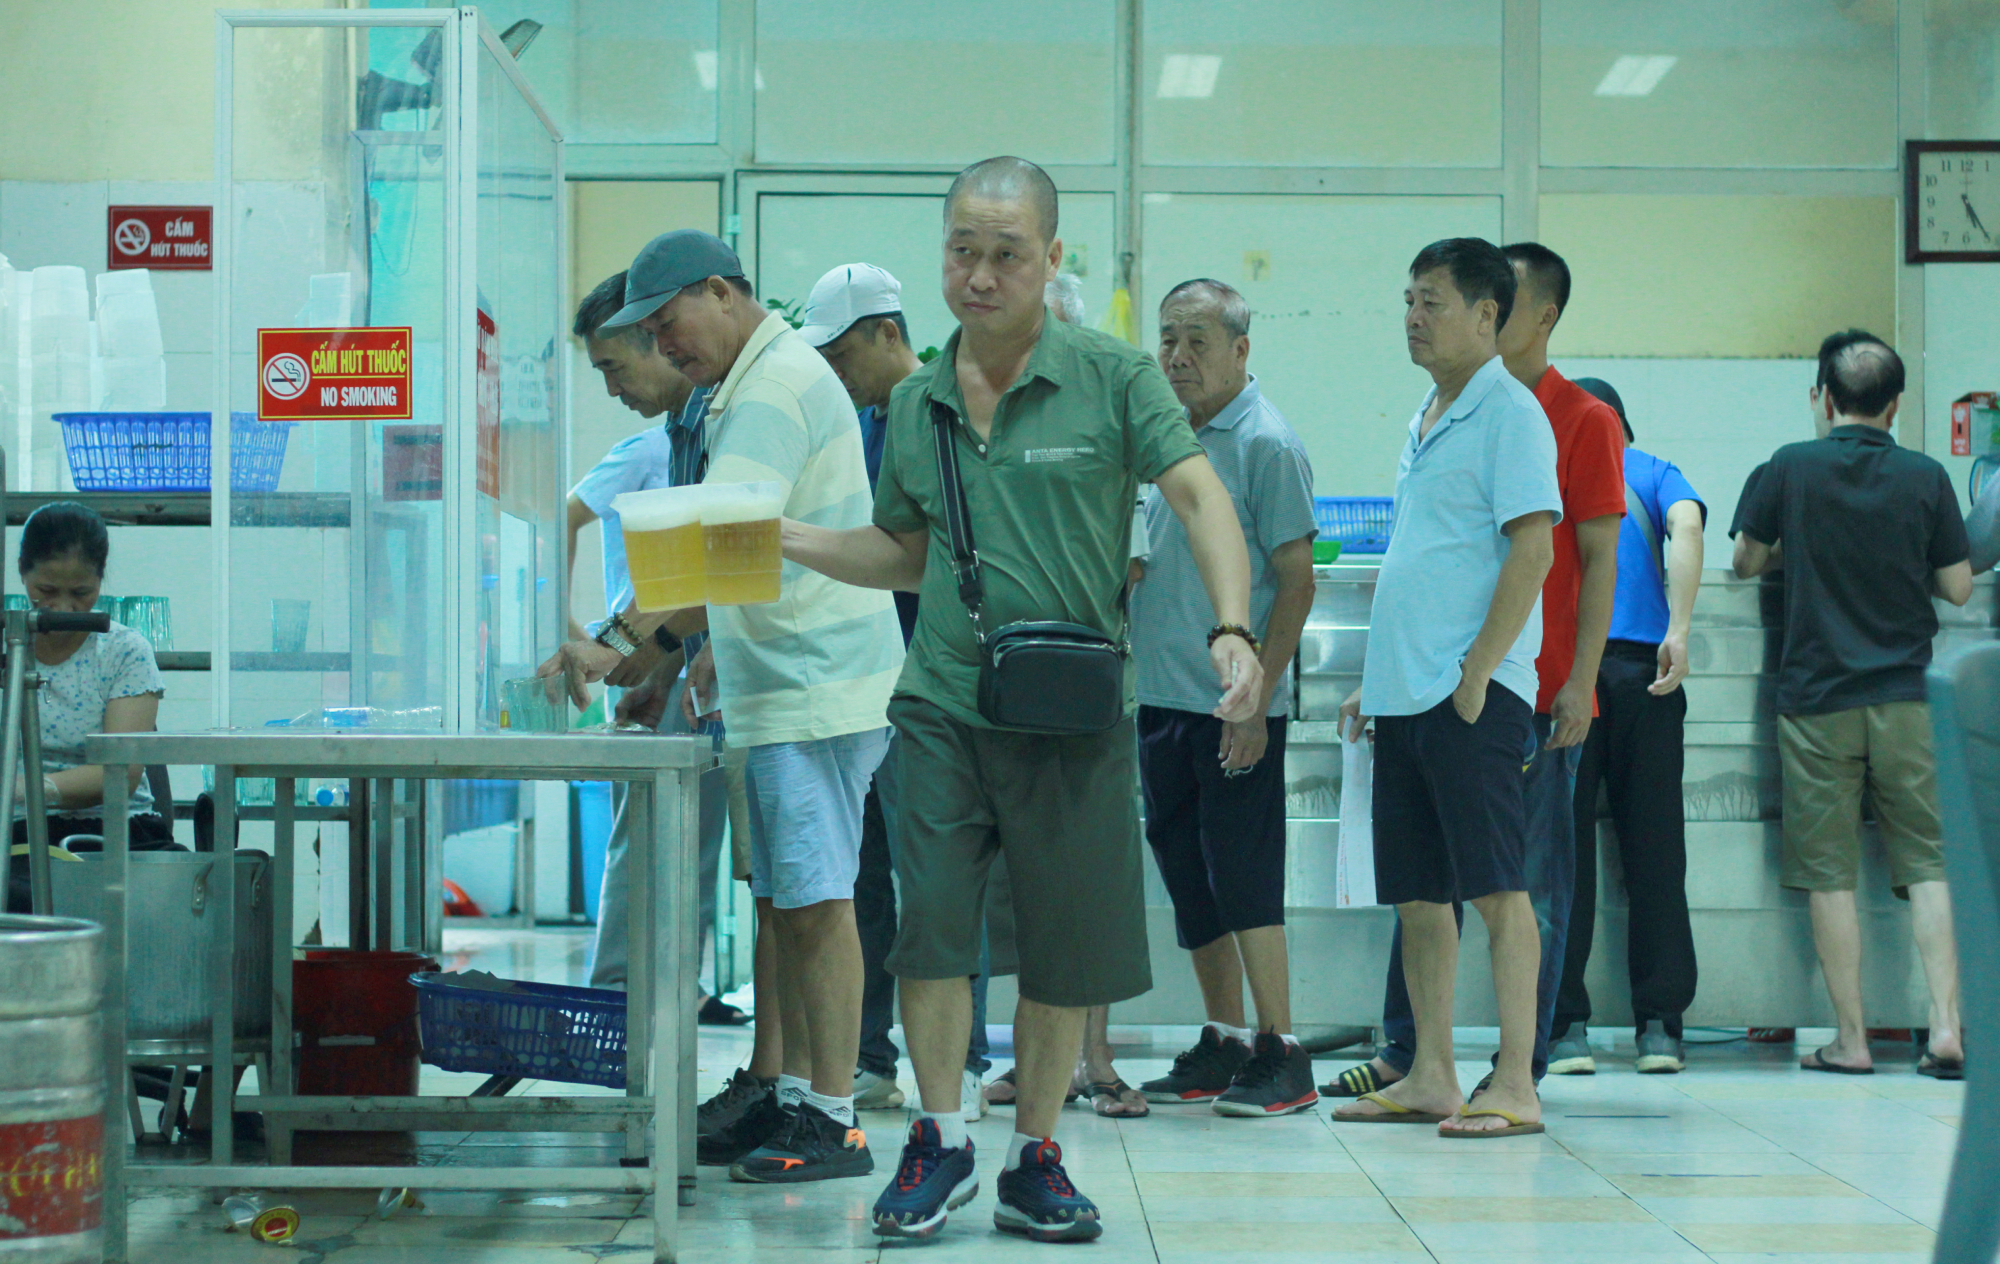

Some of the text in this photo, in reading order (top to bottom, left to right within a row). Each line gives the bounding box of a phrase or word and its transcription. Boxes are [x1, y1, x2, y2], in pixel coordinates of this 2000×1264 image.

[1941, 159, 1951, 172] 11
[1960, 159, 1974, 172] 12
[1926, 174, 1938, 187] 10
[1927, 196, 1935, 209] 9
[1942, 230, 1950, 244] 7
[1962, 231, 1970, 244] 6
[150, 240, 171, 257] HÚT
[311, 340, 406, 374] CẤM HÚT THUỐC
[321, 386, 397, 407] NO SMOKING
